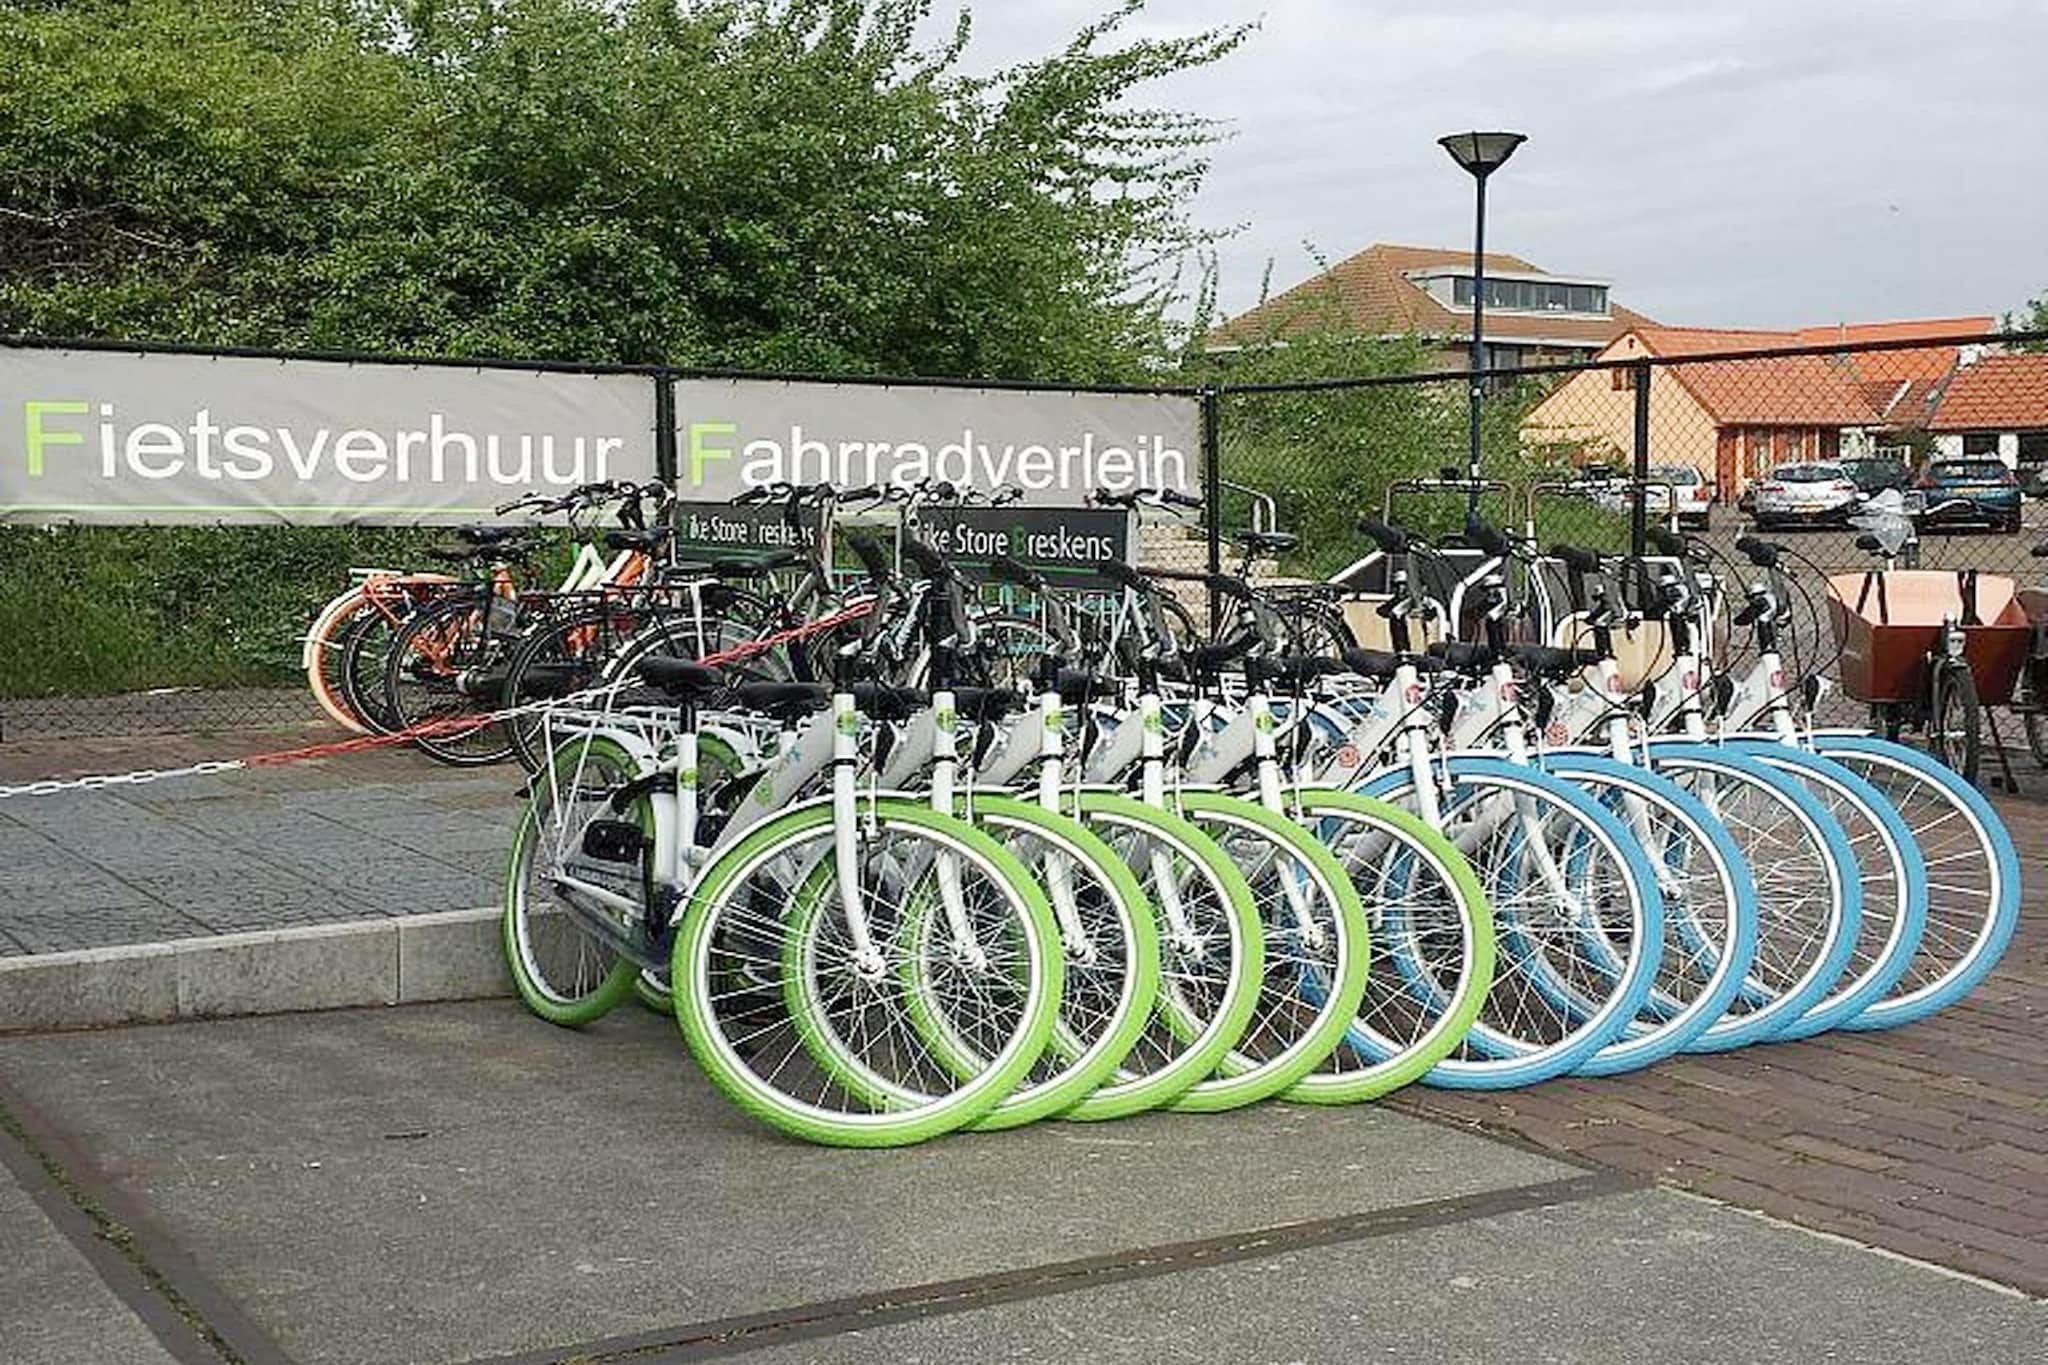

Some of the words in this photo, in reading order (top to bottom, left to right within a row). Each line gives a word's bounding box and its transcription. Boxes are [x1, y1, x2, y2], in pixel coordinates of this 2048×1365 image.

[24, 401, 624, 483] Fietsverhuur
[688, 423, 1189, 491] Fahrradverleih
[711, 515, 748, 543] Store
[918, 521, 951, 553] ike
[955, 522, 1009, 556] Store
[1012, 524, 1114, 561] Breskens
